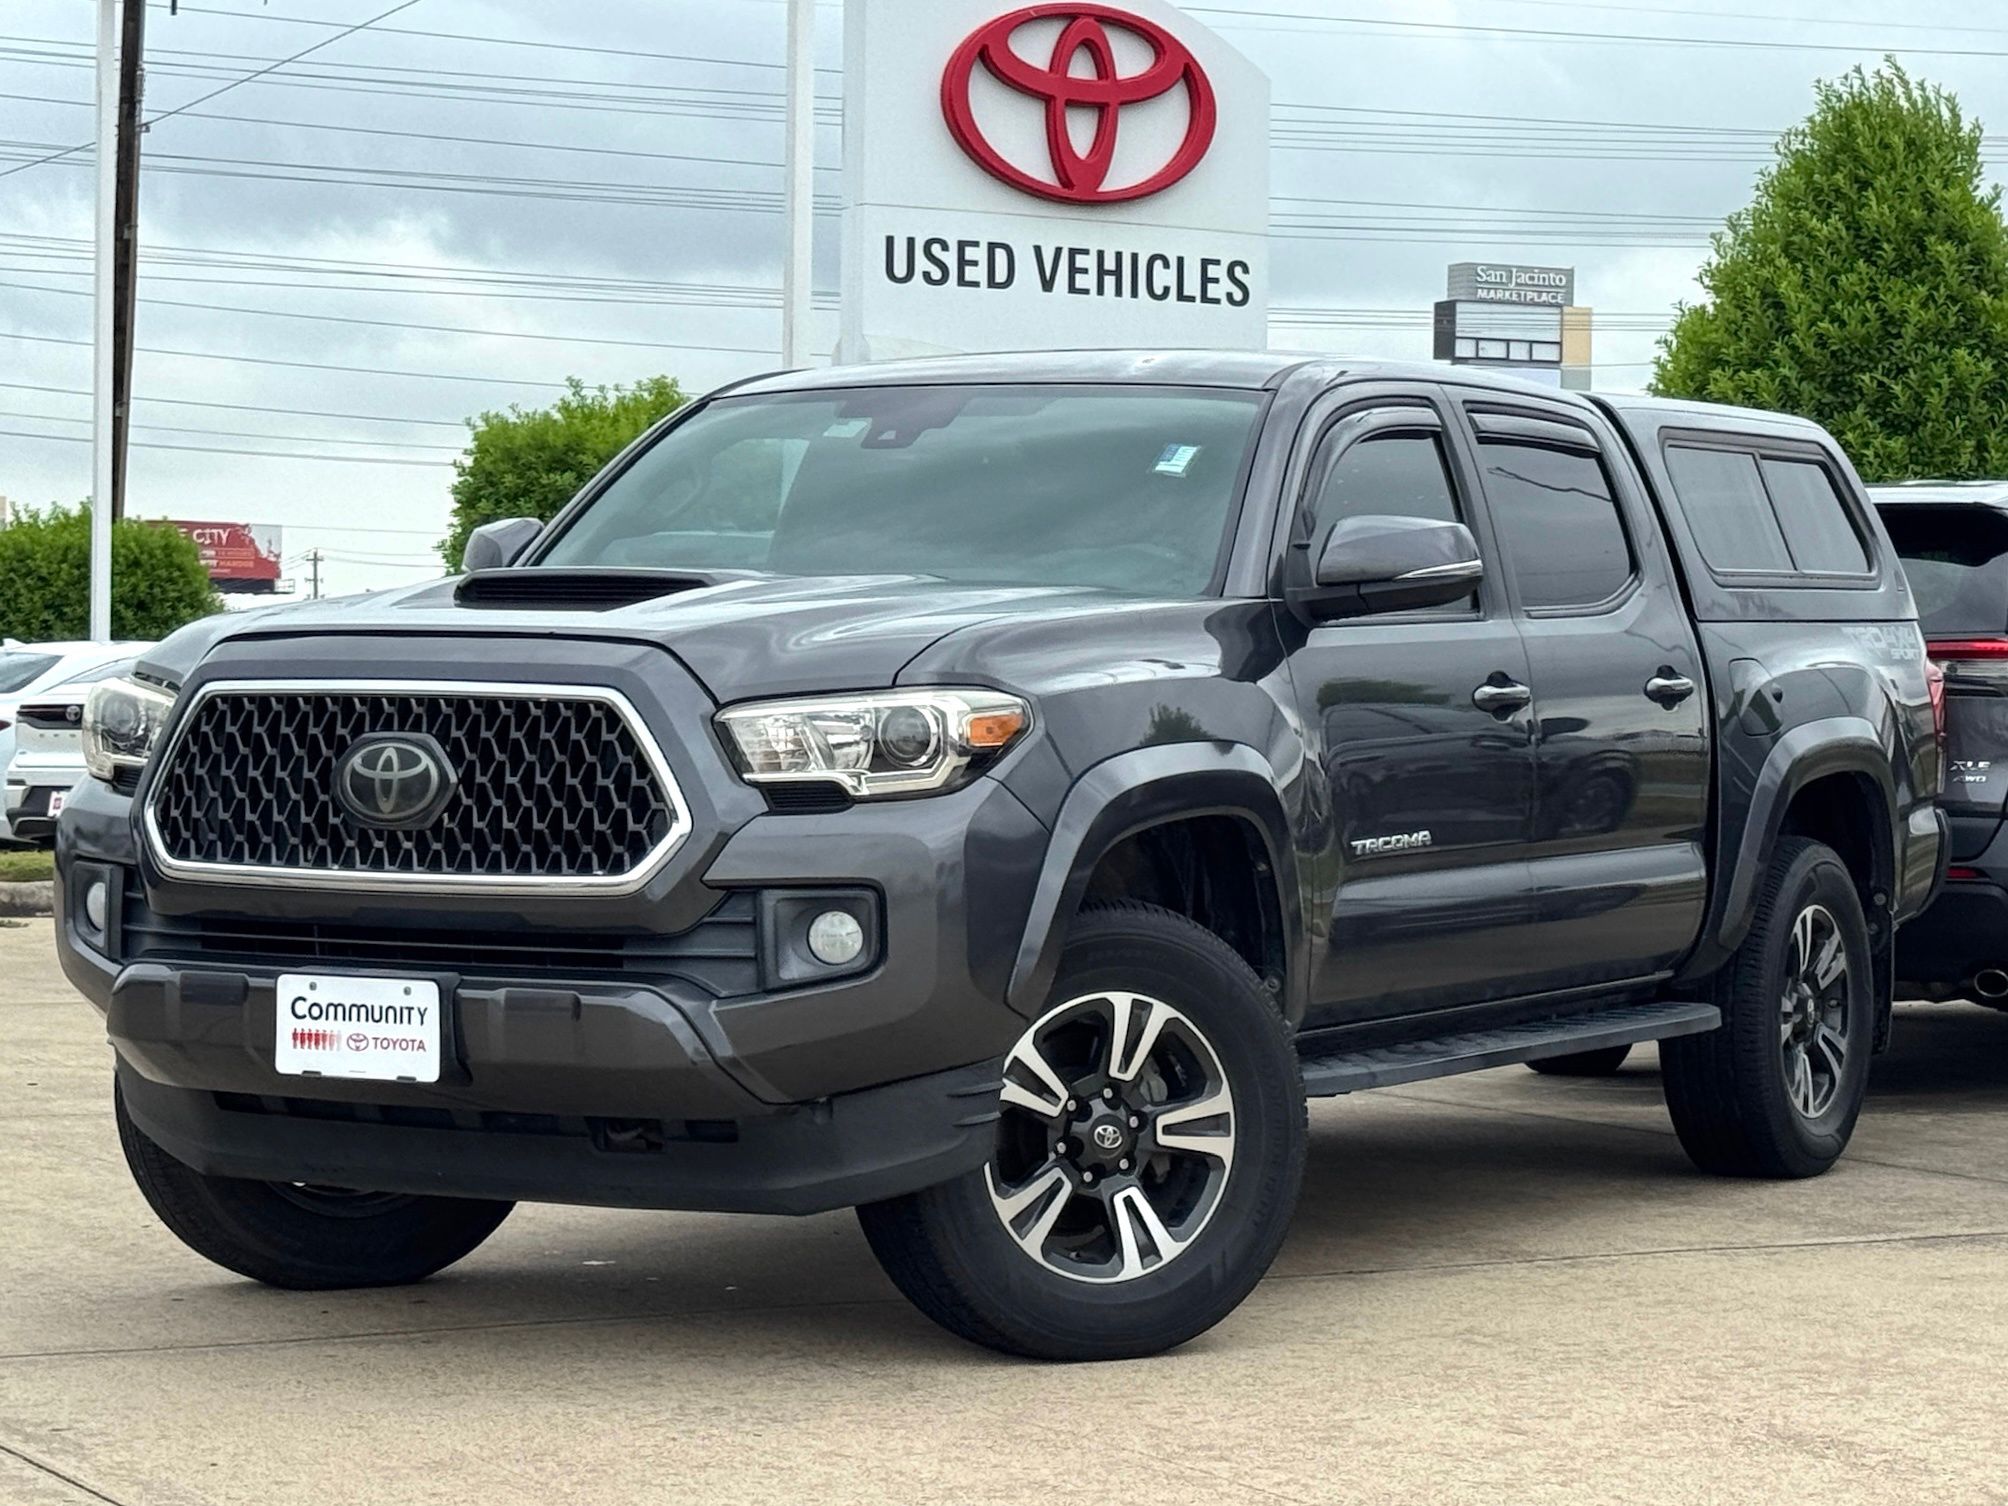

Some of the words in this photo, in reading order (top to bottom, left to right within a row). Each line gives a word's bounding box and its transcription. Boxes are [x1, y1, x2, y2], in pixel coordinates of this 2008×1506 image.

[885, 235, 1016, 290] USED
[1033, 244, 1251, 307] VEHICLES
[1476, 265, 1507, 283] San
[1509, 267, 1566, 287] Jacinto
[1477, 288, 1565, 304] MARKETPLACE
[193, 528, 231, 546] CITY
[1950, 760, 1991, 771] XLE
[1350, 830, 1432, 855] TACOMA
[372, 1037, 426, 1052] TOYOTA
